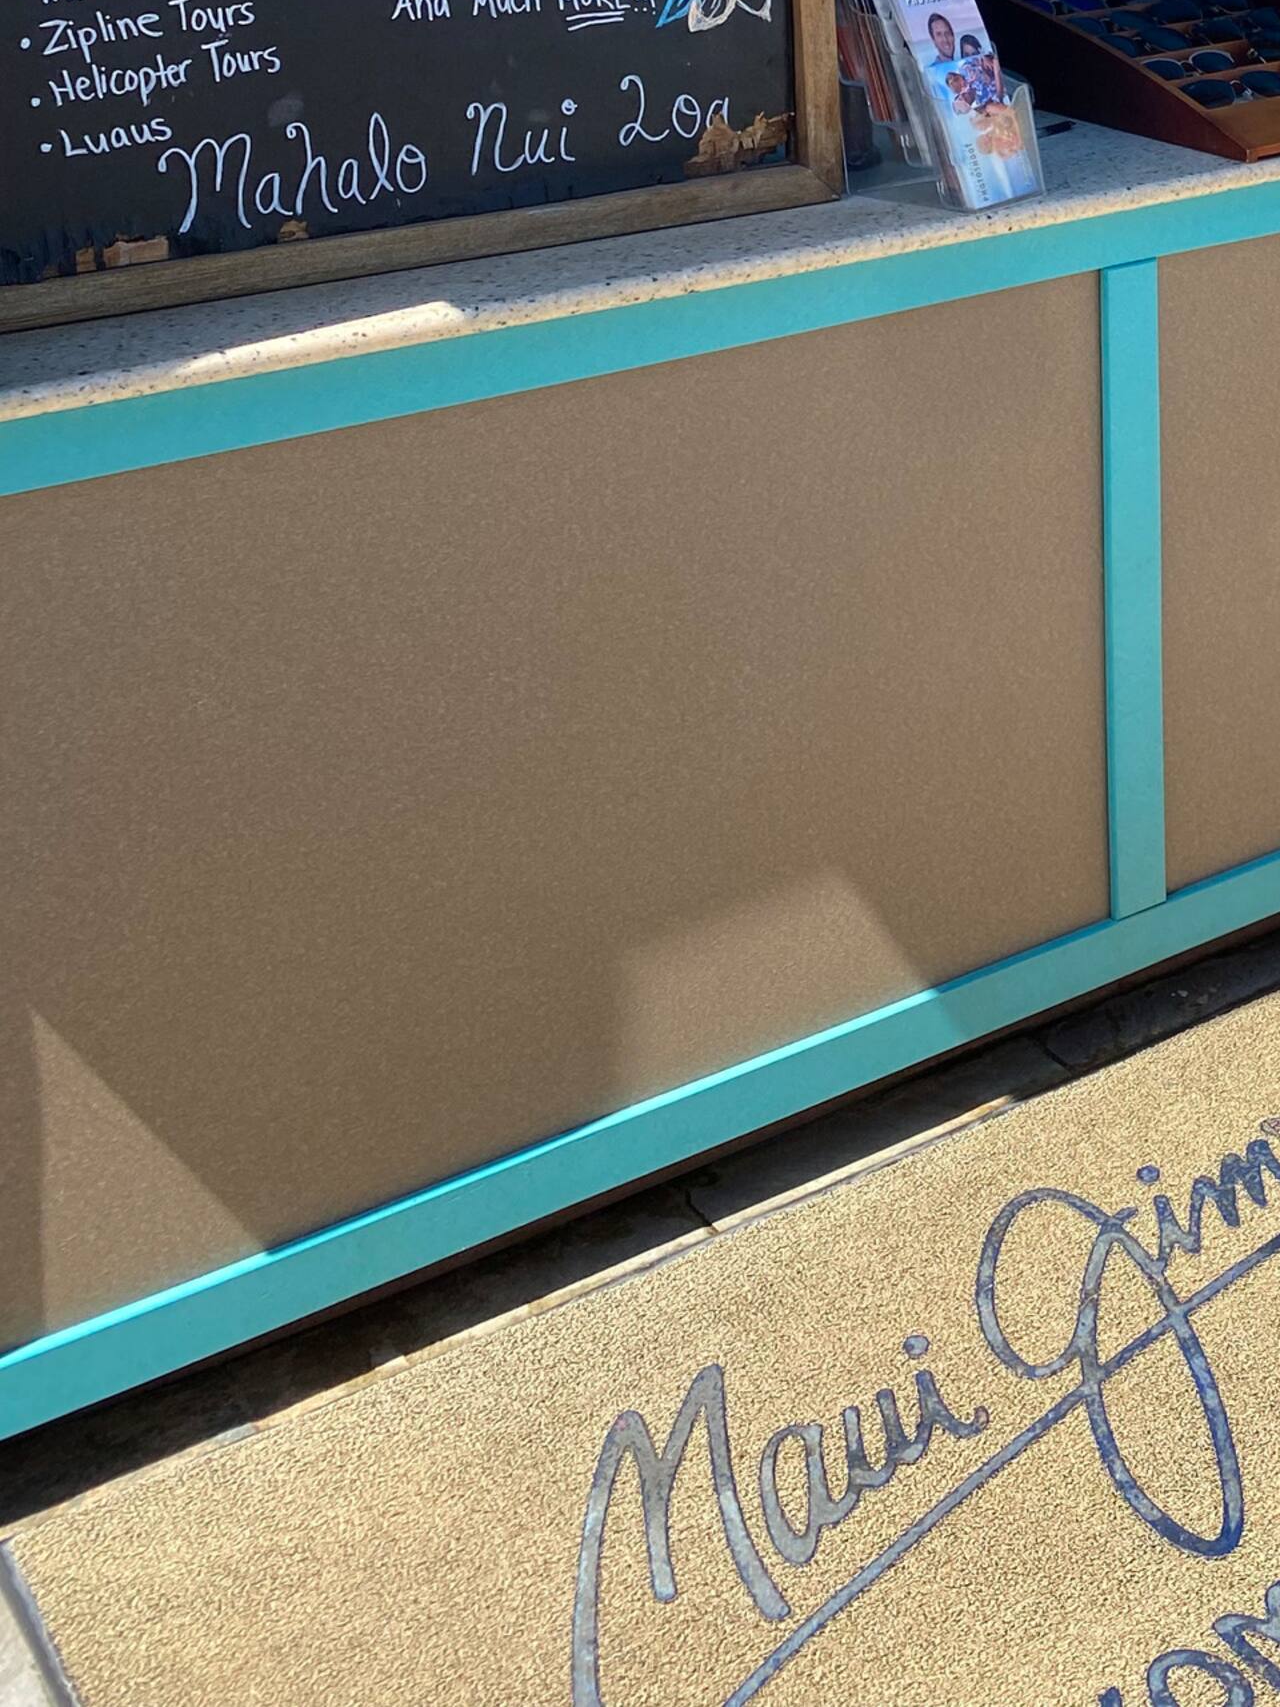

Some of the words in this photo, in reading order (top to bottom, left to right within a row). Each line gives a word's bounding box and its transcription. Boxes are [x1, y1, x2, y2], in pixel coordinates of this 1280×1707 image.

[39, 11, 164, 63] Zipline
[49, 54, 192, 106] Helicopter
[201, 39, 281, 82] Tours
[59, 117, 173, 157] Luaus
[157, 112, 427, 234] Mahalo
[572, 1334, 989, 1707] Maui
